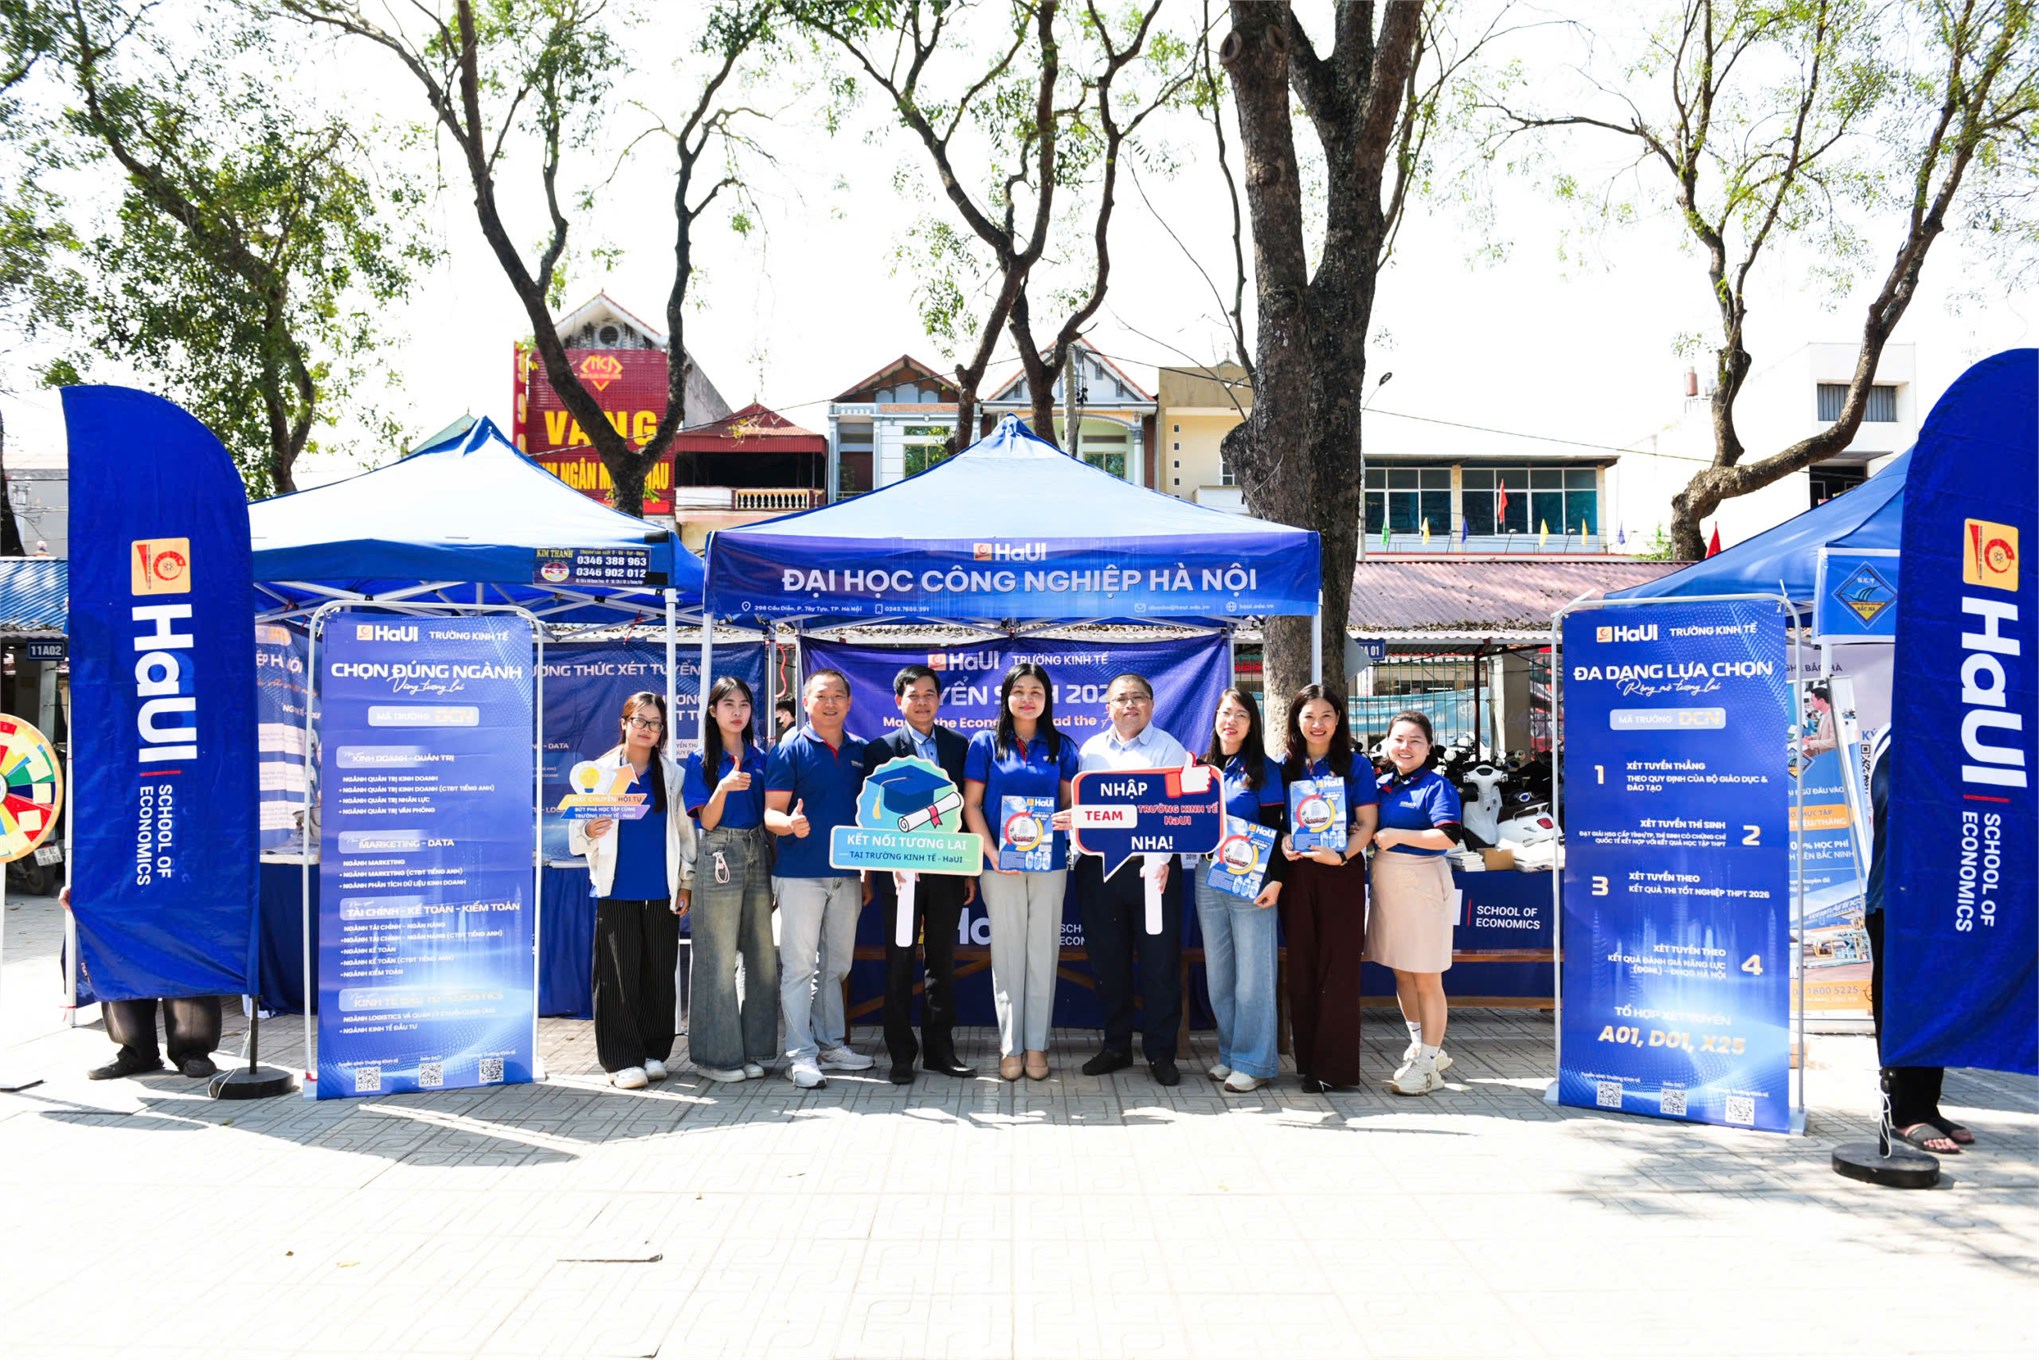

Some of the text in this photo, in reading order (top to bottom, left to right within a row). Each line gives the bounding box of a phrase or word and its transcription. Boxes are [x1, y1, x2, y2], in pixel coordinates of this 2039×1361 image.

[536, 548, 549, 558] KIM
[995, 543, 1046, 561] HaUI
[576, 555, 647, 566] 0346 388 963
[576, 567, 646, 578] 0346 902 012
[782, 562, 1257, 599] ĐẠI HỌC CÔNG NGHIỆP HÀ NỘI
[375, 625, 419, 642] HaUI
[428, 629, 510, 641] TRƯỜNG KINH TẾ
[1614, 624, 1659, 642] HaUI
[1669, 621, 1759, 637] TRƯỜNG KINH TẾ
[30, 645, 62, 656] 11A02
[948, 650, 999, 672] HaUI
[1012, 651, 1109, 666] TRƯỜNG KINH TẾ
[330, 659, 523, 680] CHỌN ĐÚNG NGÀNH
[573, 661, 647, 677] THỨC XÉT
[1573, 665, 1604, 681] ĐA
[1605, 663, 1663, 682] DẠNG
[1666, 661, 1708, 681] LỰA
[1711, 661, 1773, 678] CHỌN
[131, 604, 198, 763] HaUI
[1960, 596, 2028, 788] HaUI
[1075, 715, 1098, 727] the
[1678, 711, 1721, 726] DCN
[1626, 758, 1706, 771] XÉT TUYỂN THẲNG
[1594, 764, 1605, 785] 1
[1626, 774, 1648, 783] THEO
[1648, 775, 1665, 784] QUY
[1666, 775, 1686, 784] ĐỊNH
[1687, 774, 1705, 783] CỦA
[1706, 774, 1719, 785] BỘ
[1742, 775, 1760, 784] DỤC
[1100, 778, 1148, 800] NHẬP
[1626, 783, 1662, 793] ĐÀO TẠO
[617, 794, 642, 804] HỘI TỤ
[1034, 798, 1054, 807] HaUI
[1137, 801, 1219, 814] TRƯỜNG KINH TẾ
[1085, 810, 1123, 821] TEAM
[1164, 815, 1192, 826] HaUI
[1640, 818, 1656, 828] XÉT
[1657, 817, 1687, 829] TUYỂN
[1703, 820, 1726, 829] SINH
[136, 786, 154, 886] ECONOMICS
[156, 784, 173, 879] SCHOOL OF
[1256, 826, 1278, 839] HaUI
[1741, 824, 1761, 846] 2
[358, 838, 420, 849] MARKETING
[427, 838, 455, 847] DATA
[847, 832, 967, 851] KẾT NỐI TƯƠNG LAI
[1131, 835, 1174, 850] NHA!
[1814, 841, 1833, 851] HỌC
[1834, 839, 1849, 849] PHÍ
[850, 851, 864, 861] TẠI
[865, 851, 902, 861] TRƯỜNG
[927, 853, 937, 862] TẾ
[942, 856, 963, 864] HaUI
[1816, 848, 1833, 860] BẮC
[1628, 870, 1701, 883] XÉT TUYỂN THEO
[1955, 811, 1979, 933] ECONOMICS
[1979, 812, 2001, 928] SCHOOL OF
[1591, 876, 1609, 897] 3
[1628, 883, 1770, 899] KẾT QUẢ THI TỐT NGHIỆP THPT 2026
[423, 903, 455, 915] TOÁN
[462, 900, 491, 914] KIỂM
[491, 900, 521, 911] TOÁN
[1476, 905, 1538, 917] SCHOOL OF
[1475, 917, 1541, 930] ECONOMICS
[1653, 943, 1727, 957] XÉT TUYỂN THEO
[1741, 954, 1764, 975] 4
[1834, 985, 1859, 994] 5225
[1614, 1003, 1661, 1020] TỔ HỢP
[1598, 1025, 1746, 1056] A01, D01, X25
